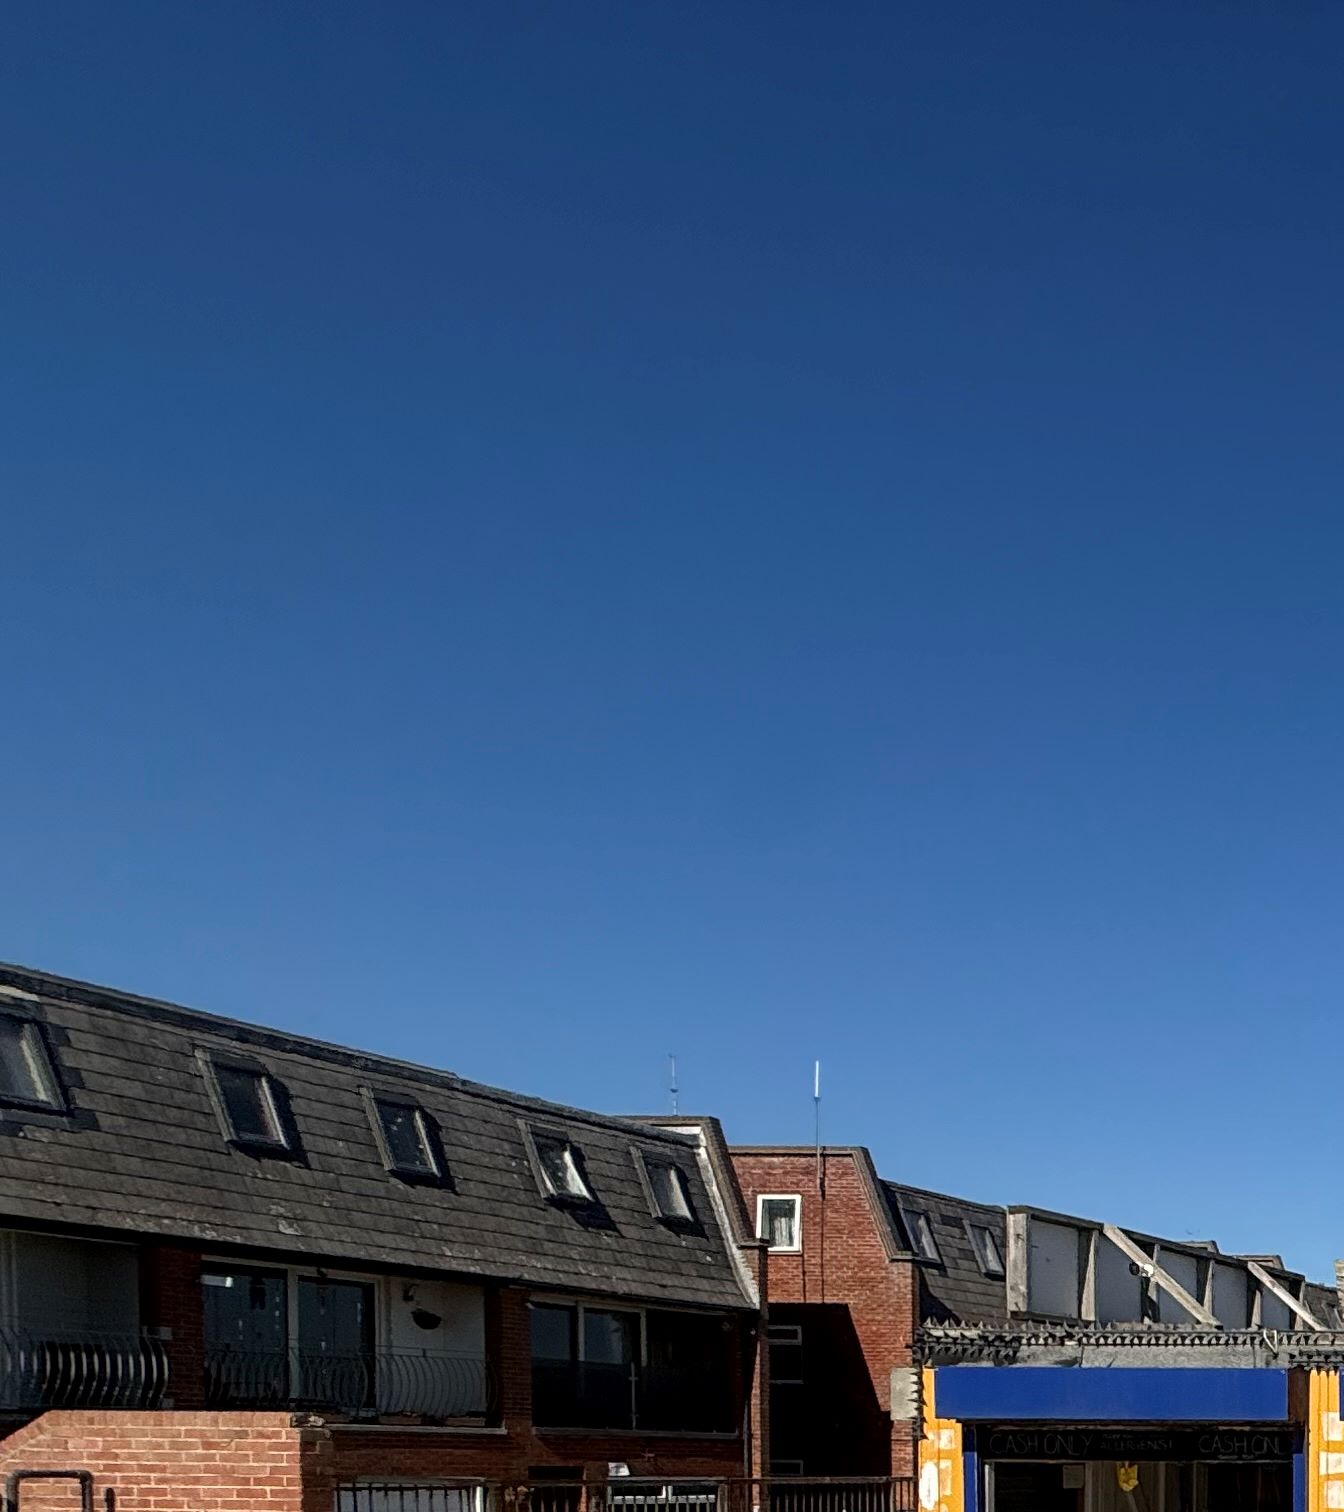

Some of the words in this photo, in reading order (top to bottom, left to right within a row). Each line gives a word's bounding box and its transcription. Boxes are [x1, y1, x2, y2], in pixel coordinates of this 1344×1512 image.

[990, 1433, 1039, 1455] CASH
[1044, 1433, 1094, 1457] ONLY
[1199, 1434, 1247, 1454] CASH
